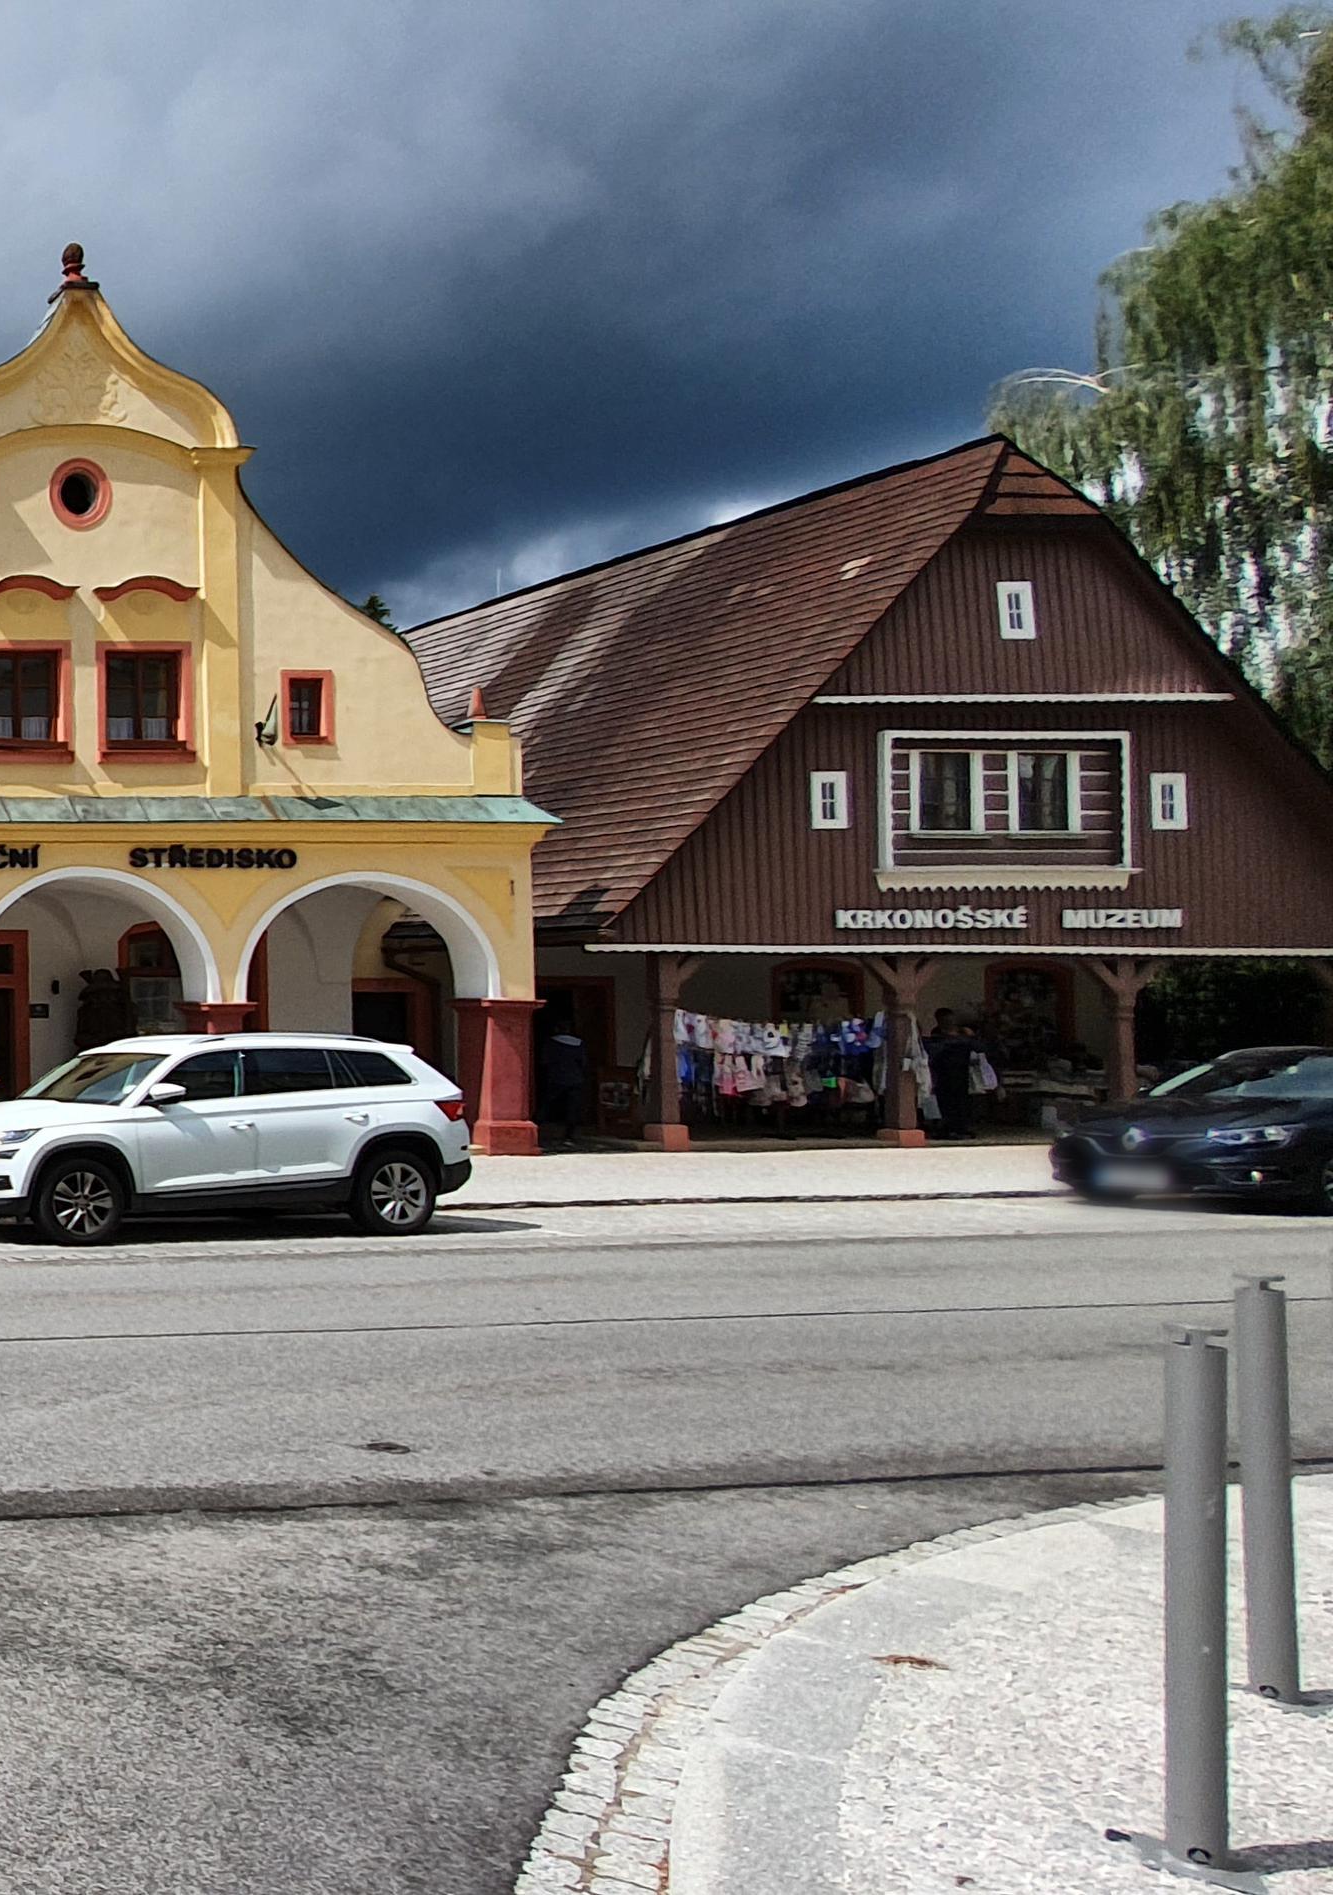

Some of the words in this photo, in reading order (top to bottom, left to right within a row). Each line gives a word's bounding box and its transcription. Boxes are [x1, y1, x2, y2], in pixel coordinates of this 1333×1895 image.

[128, 843, 298, 869] STŘEDISKO
[834, 904, 1029, 929] KRKONOŠSKÉ
[1061, 907, 1183, 929] MUZEUM
